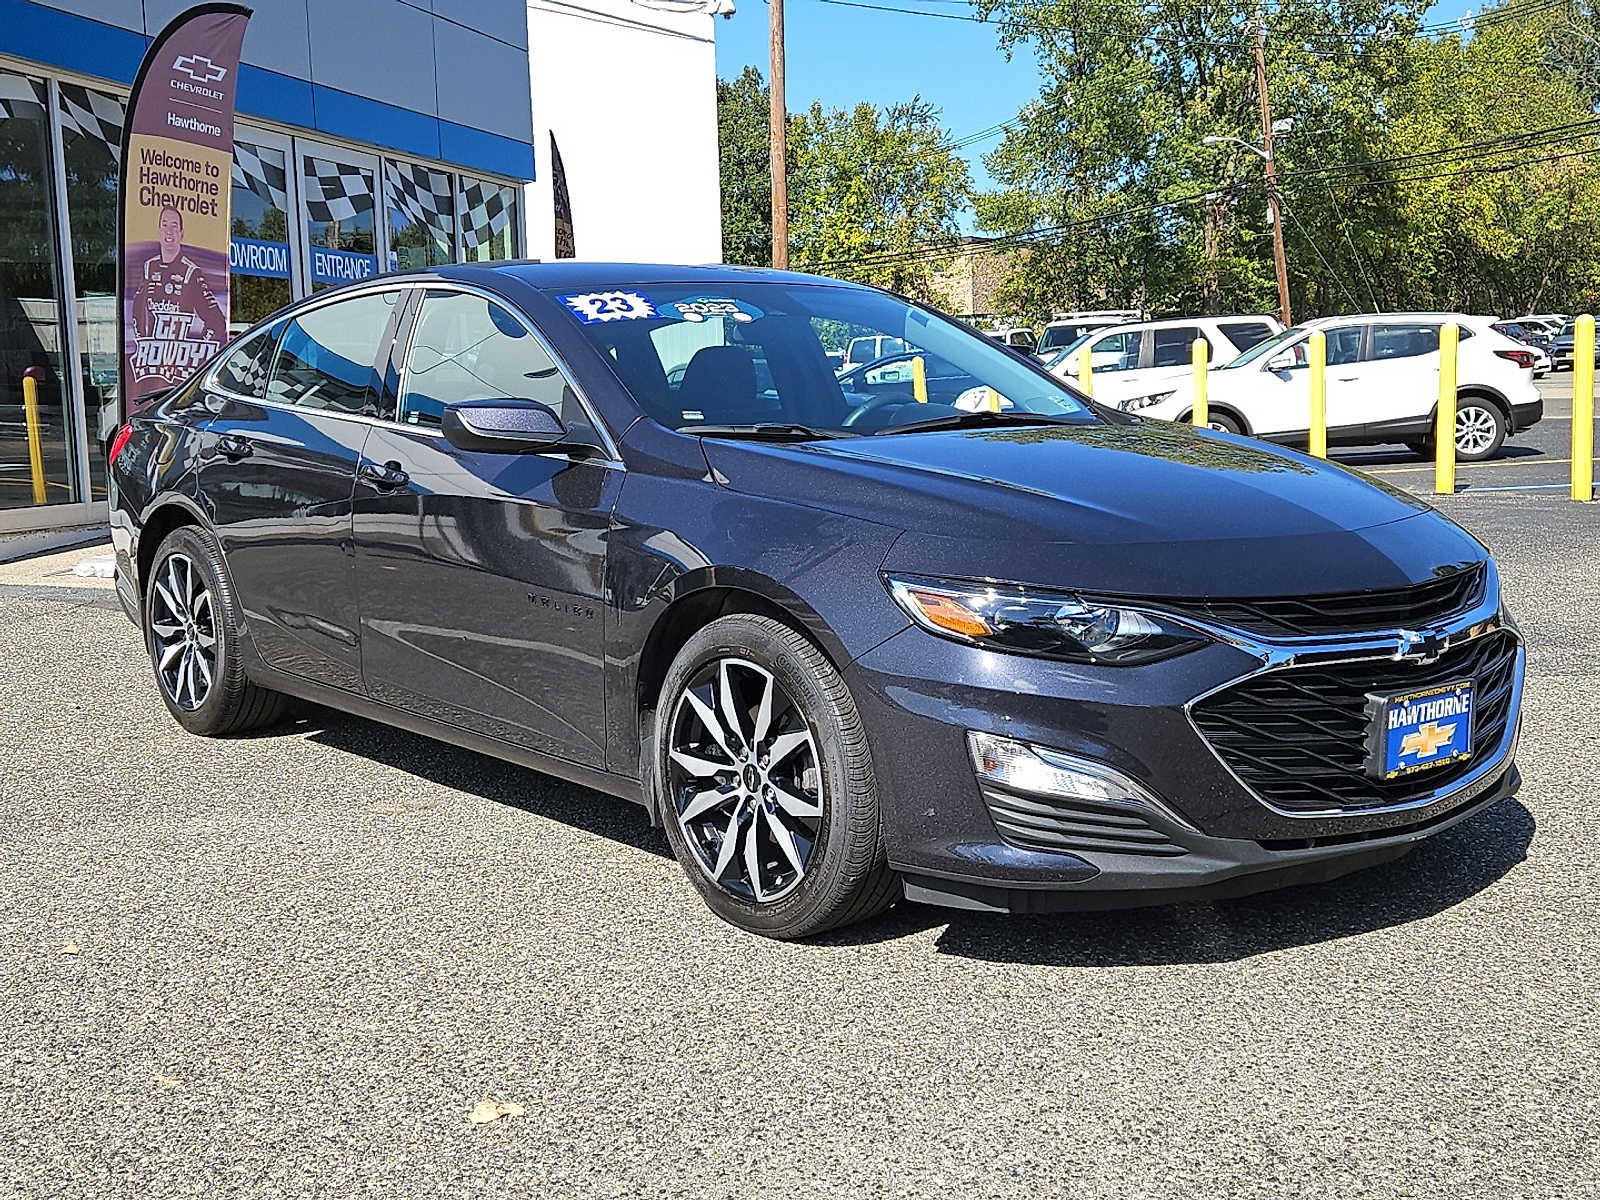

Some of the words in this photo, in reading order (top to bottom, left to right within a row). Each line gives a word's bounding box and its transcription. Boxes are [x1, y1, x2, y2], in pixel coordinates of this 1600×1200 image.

[170, 80, 224, 100] CHEVROLET
[167, 112, 221, 137] Hawthorne
[141, 148, 201, 173] Welcome
[205, 161, 219, 178] to
[139, 167, 219, 196] Hawthorne
[139, 186, 218, 217] Chevrolet
[230, 242, 287, 272] OWROOM
[315, 253, 371, 279] ENTRANCE
[589, 296, 634, 314] 23
[674, 303, 740, 313] 2023
[155, 314, 192, 340] GET
[1388, 693, 1469, 730] HAWTHORNE
